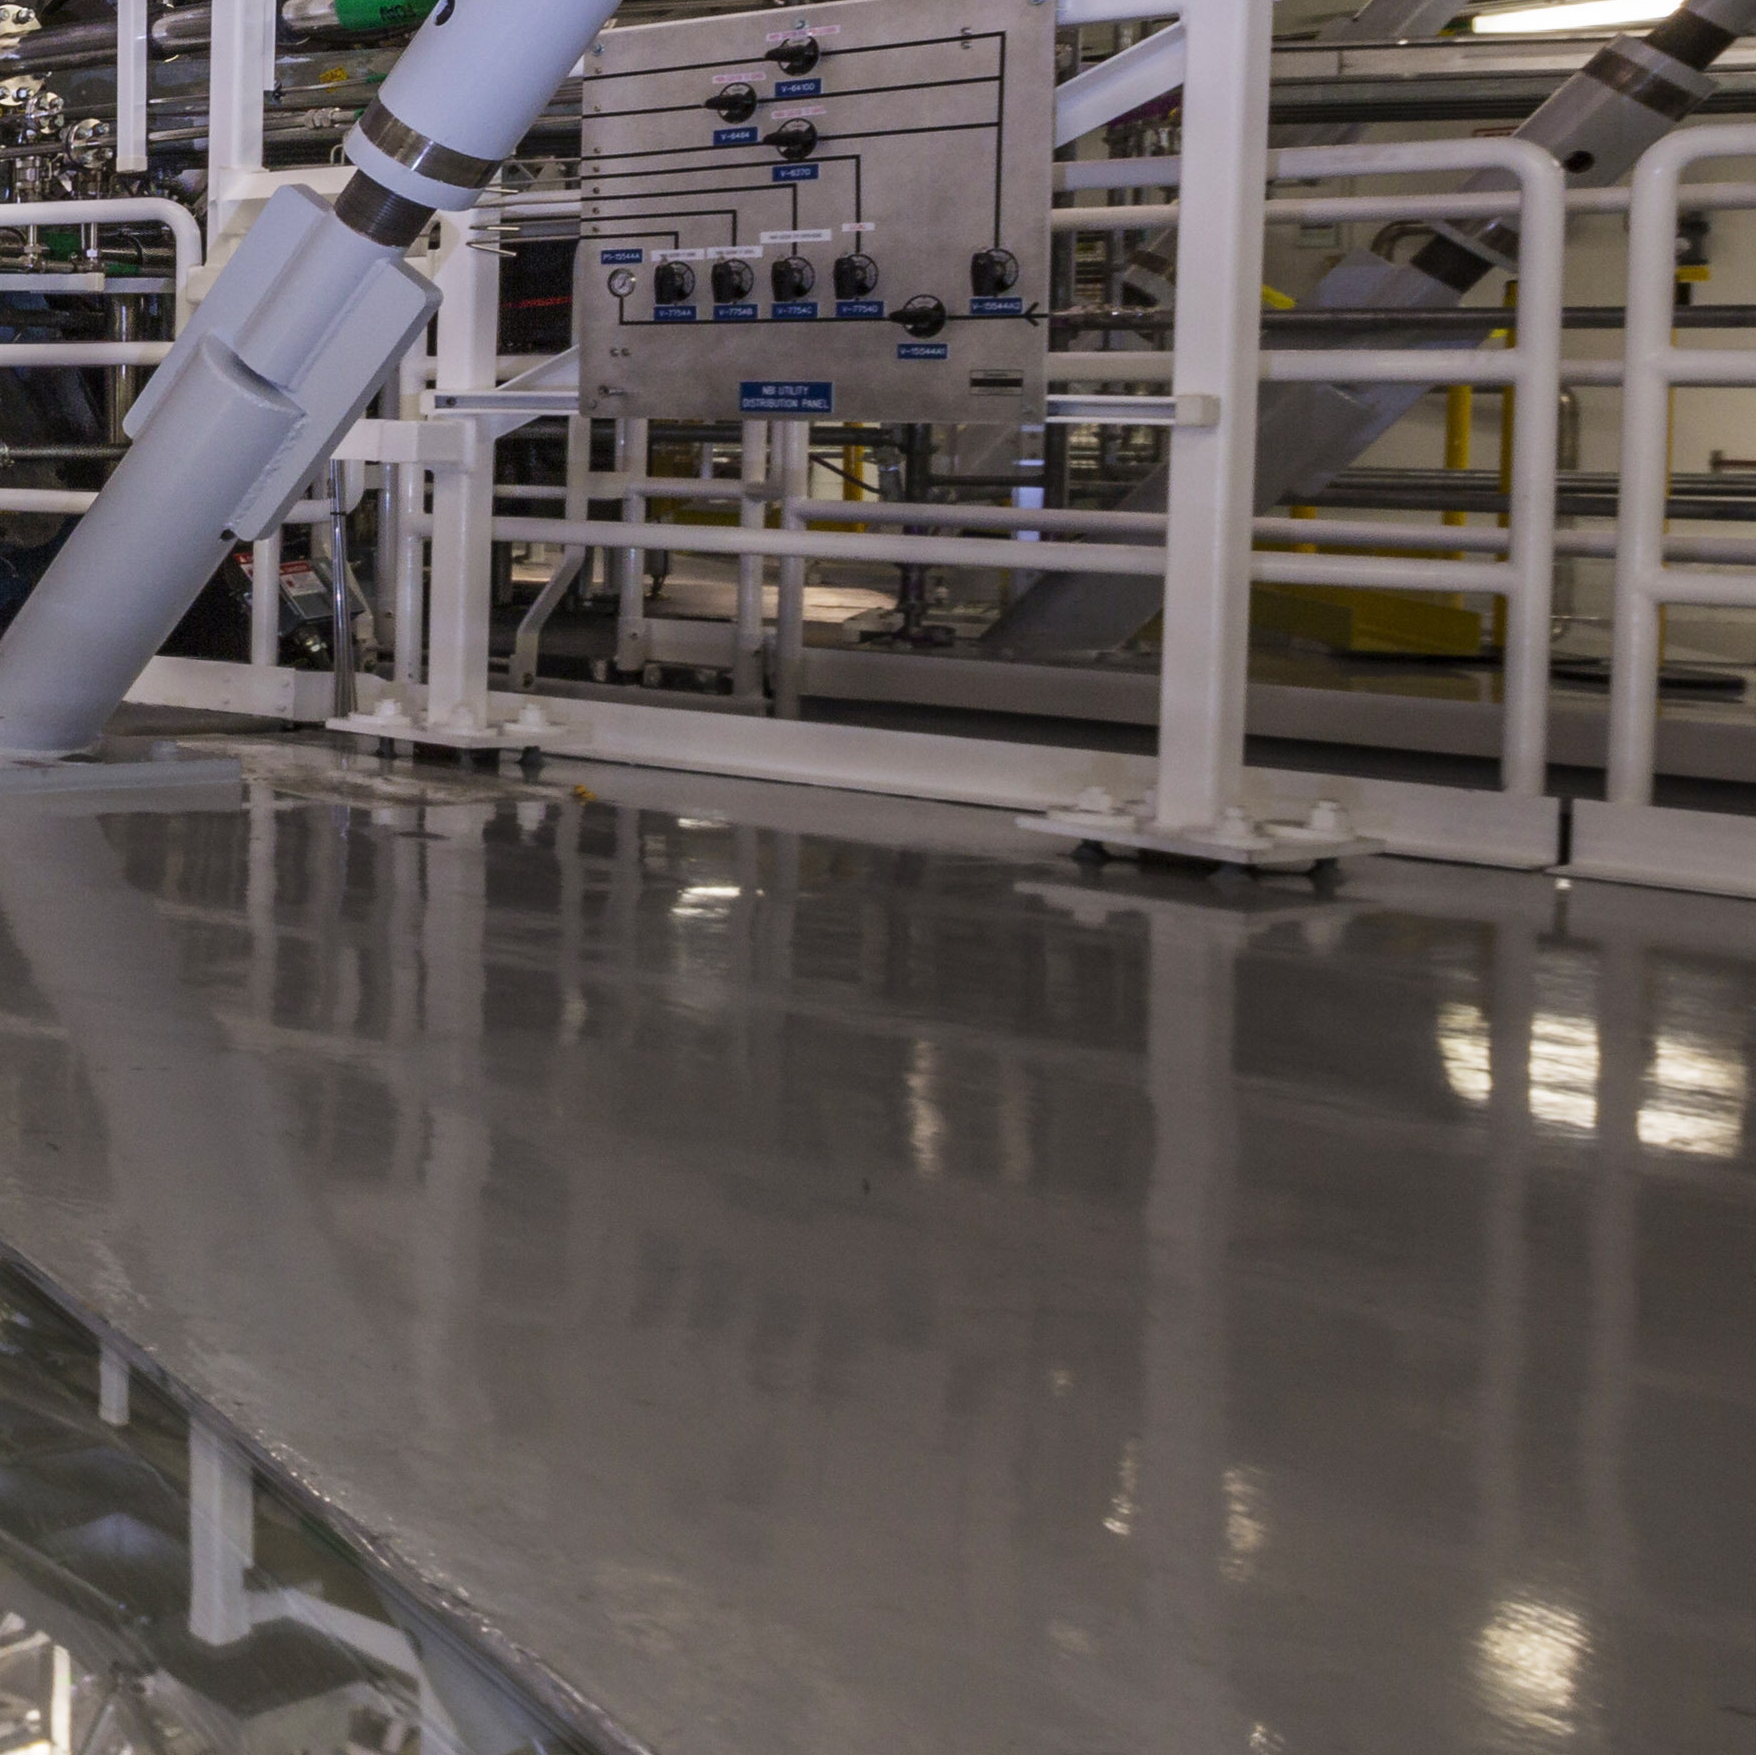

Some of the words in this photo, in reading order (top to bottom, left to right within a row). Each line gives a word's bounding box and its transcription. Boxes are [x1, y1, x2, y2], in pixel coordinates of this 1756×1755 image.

[778, 385, 810, 395] UTILITY
[742, 398, 799, 408] DISTRIBUTION
[801, 398, 829, 409] PANEL
